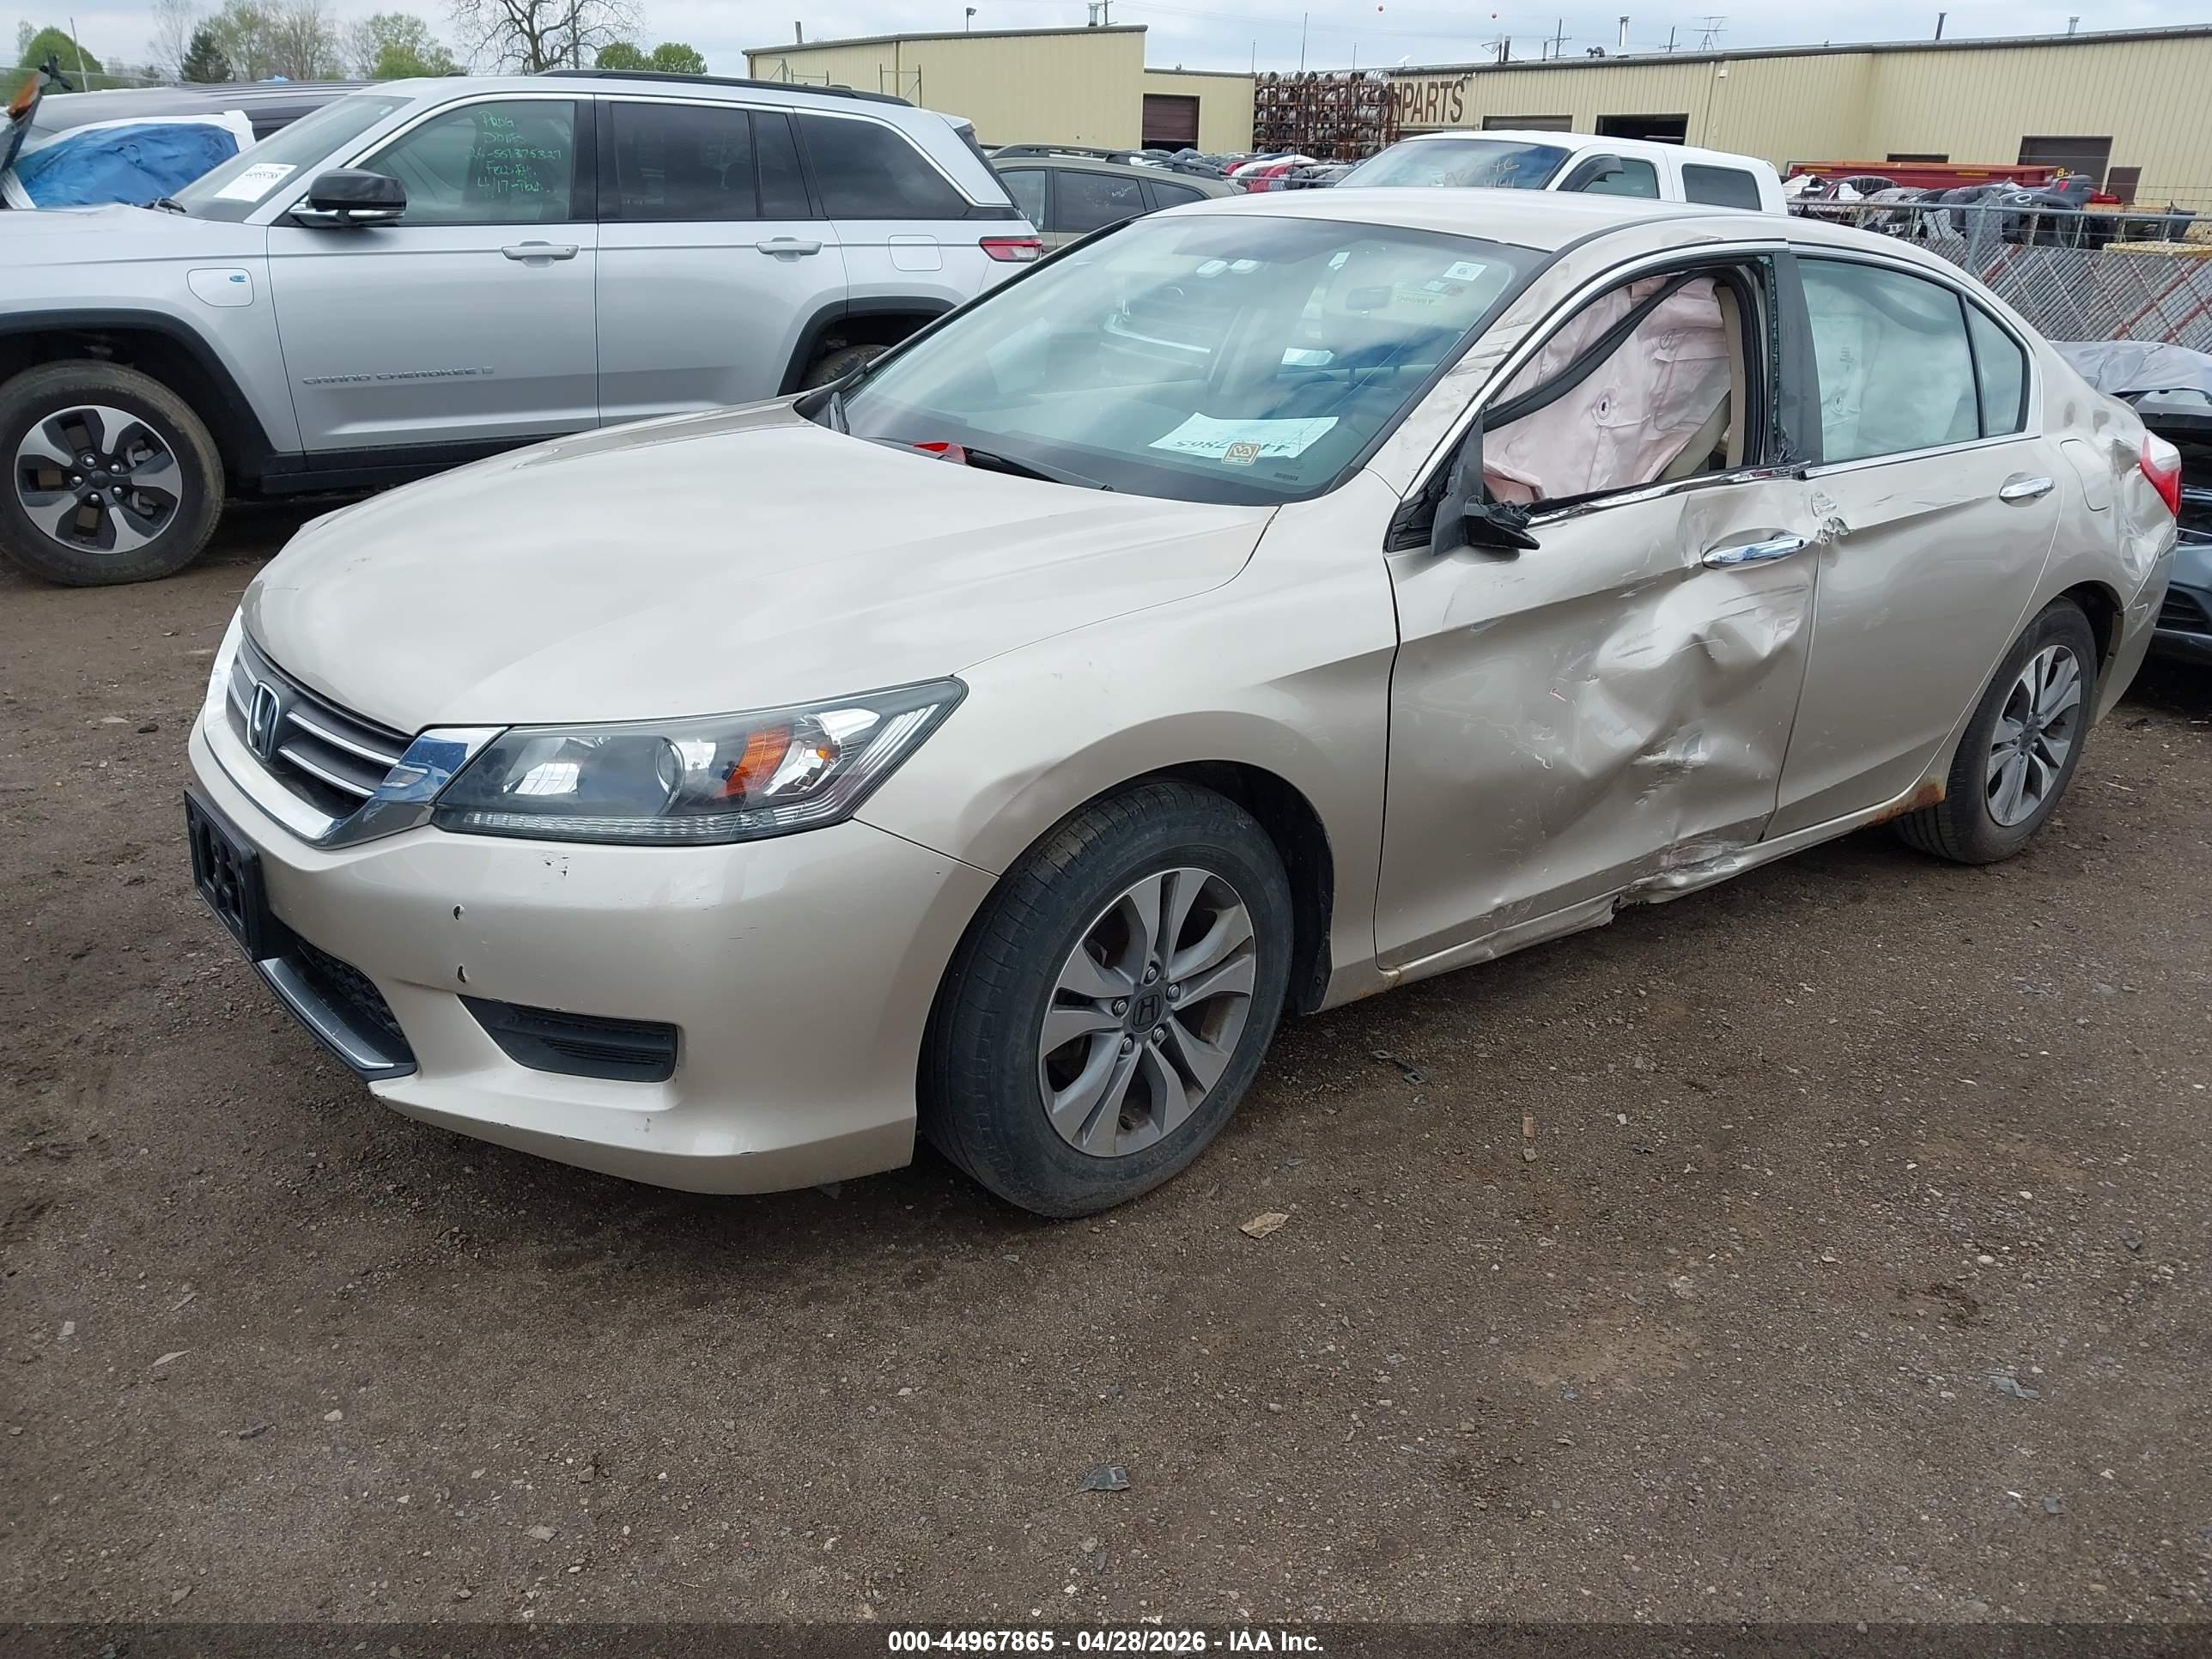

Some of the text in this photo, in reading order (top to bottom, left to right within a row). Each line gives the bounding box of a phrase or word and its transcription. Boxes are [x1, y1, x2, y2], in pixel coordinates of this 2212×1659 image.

[1401, 80, 1465, 123] PARTS
[302, 368, 477, 385] GRAND CHEROKEE
